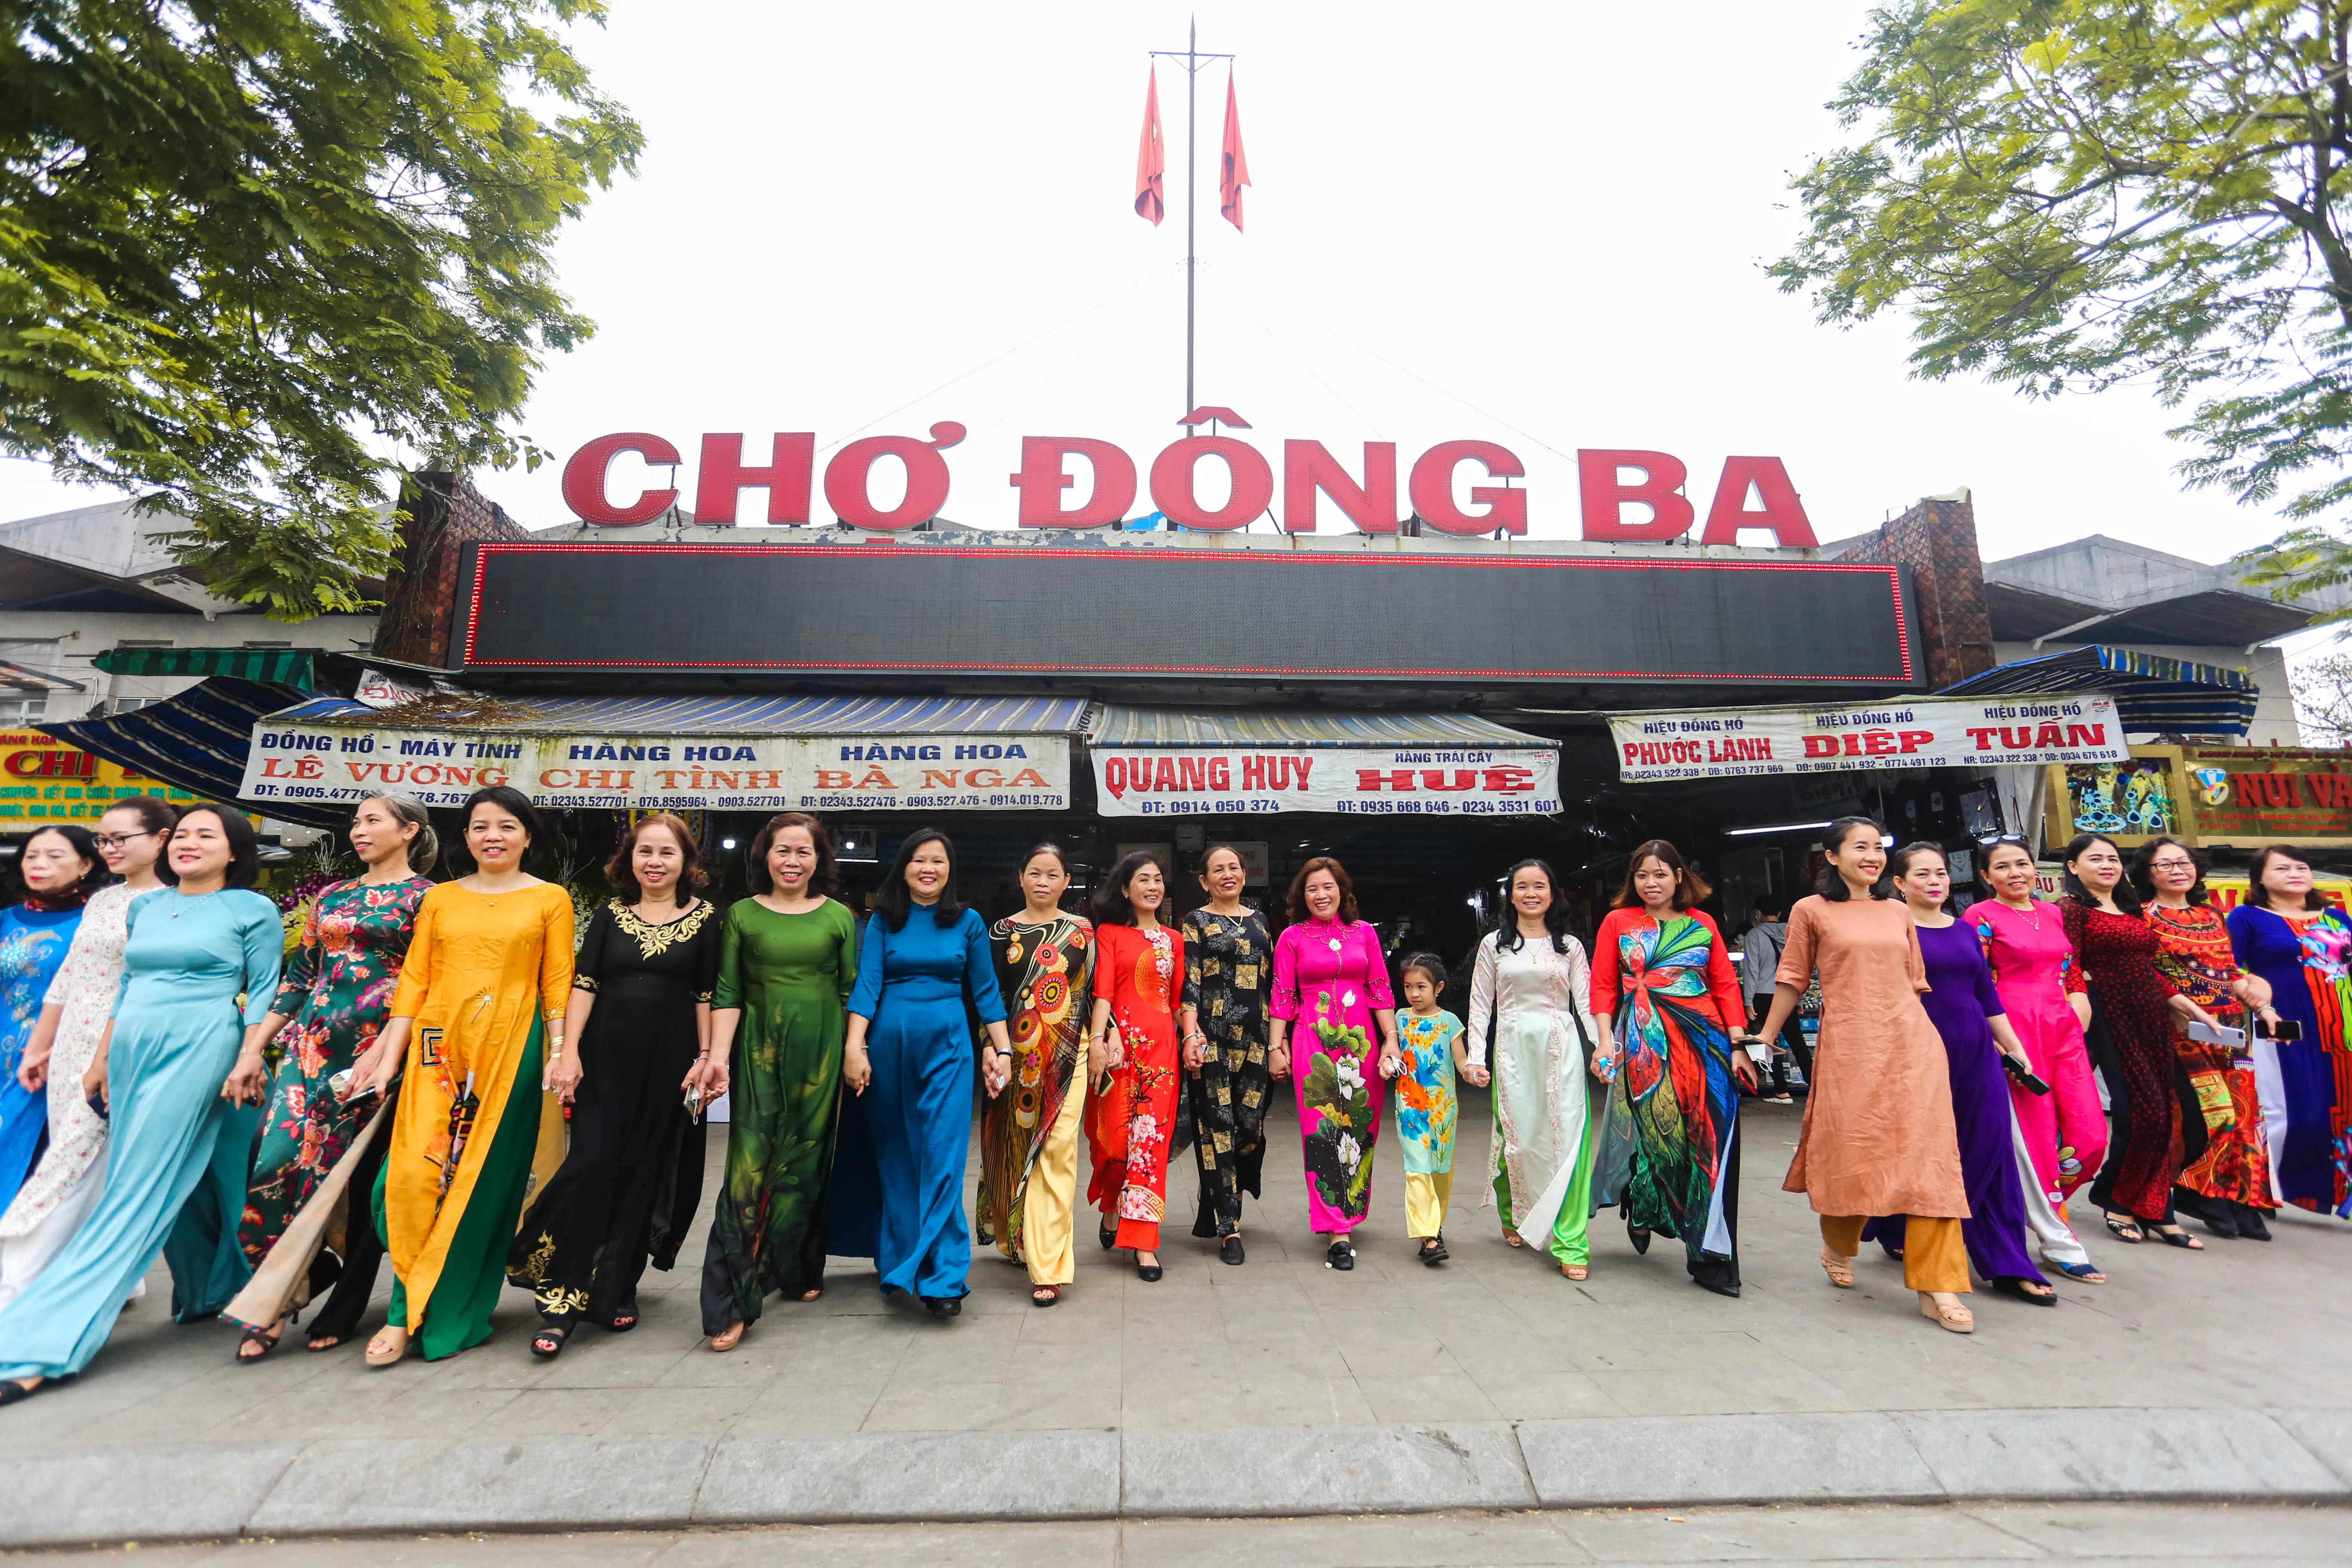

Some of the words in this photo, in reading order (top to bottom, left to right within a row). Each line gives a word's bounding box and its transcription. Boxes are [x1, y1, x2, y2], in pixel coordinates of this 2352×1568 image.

[561, 421, 967, 544] CHỢ
[1010, 406, 1527, 535] ĐÔNG
[1576, 449, 1819, 548] BA
[1816, 714, 1848, 728] HIỆU
[1853, 710, 1891, 725] ĐỒNG
[1895, 708, 1913, 723] HỒ
[1984, 705, 2016, 720] HIỆU
[2020, 703, 2058, 717] ĐỒNG
[2063, 701, 2081, 715] HỒ
[1644, 720, 1676, 735] HIỆU
[1681, 717, 1721, 732] ĐỒNG
[1725, 716, 1743, 730] HỒ
[1966, 717, 2105, 750] TUẤN
[261, 729, 332, 751] ĐỒNG
[341, 733, 374, 753] HỒ
[400, 739, 456, 756] MÁY
[569, 743, 670, 761] HÀNG
[684, 747, 756, 761] HOA
[841, 743, 940, 760] HÀNG
[955, 744, 1027, 759] HOA
[1623, 736, 1702, 766] PHƯỚC
[1707, 735, 1773, 763] LÀNH
[1802, 728, 1934, 760] DIỆP
[4, 750, 97, 783] CHỊ
[1396, 751, 1431, 763] HÀNG
[1436, 751, 1464, 762] TRÁI
[1468, 751, 1492, 762] CÂY
[1814, 762, 1836, 771] 0907
[1840, 761, 1855, 769] 441
[1859, 760, 1876, 769] 932
[1885, 760, 1908, 768] 0774
[1911, 758, 1926, 766] 491
[1931, 757, 1946, 765] 123
[1964, 756, 1977, 764] NR:
[1980, 755, 2003, 764] 02343
[2006, 754, 2020, 762] 322
[2023, 753, 2037, 761] 338
[2083, 751, 2098, 759] 676
[260, 754, 324, 779] LÊ
[345, 761, 509, 787] VƯƠNG
[540, 769, 635, 793] CHỊ
[654, 765, 783, 789] TÌNH
[813, 764, 899, 789] BÀ
[920, 769, 1051, 788] NGA
[1106, 756, 1230, 800] QUANG
[1242, 756, 1313, 790] HUY
[1356, 764, 1535, 795] HUỆ
[1666, 769, 1681, 777] 522
[1683, 768, 1699, 776] 338
[1725, 766, 1746, 775] 0763
[1749, 766, 1764, 774] 737
[1767, 765, 1783, 773] 969
[254, 784, 279, 796] ĐT:
[2232, 763, 2303, 807] NÚI
[533, 796, 548, 806] ĐT:
[551, 796, 627, 807] 02343.527701
[639, 796, 707, 807] 076.8595964
[718, 796, 785, 807] 0903.527701
[801, 796, 816, 806] ĐT:
[820, 796, 896, 807] 02343.527476
[907, 796, 979, 807] 0903.527.476
[990, 795, 1062, 805] 0914.019.778
[1142, 802, 1165, 813] ĐT:
[1171, 801, 1210, 813] 0914
[1216, 800, 1245, 812] 050
[1251, 799, 1280, 812] 374
[1337, 801, 1356, 812] ĐT:
[1360, 801, 1392, 812] 0935
[1397, 801, 1421, 812] 668
[1425, 801, 1449, 812] 646
[1463, 801, 1494, 812] 0234
[1499, 800, 1528, 812] 3531
[1535, 799, 1557, 812] 601
